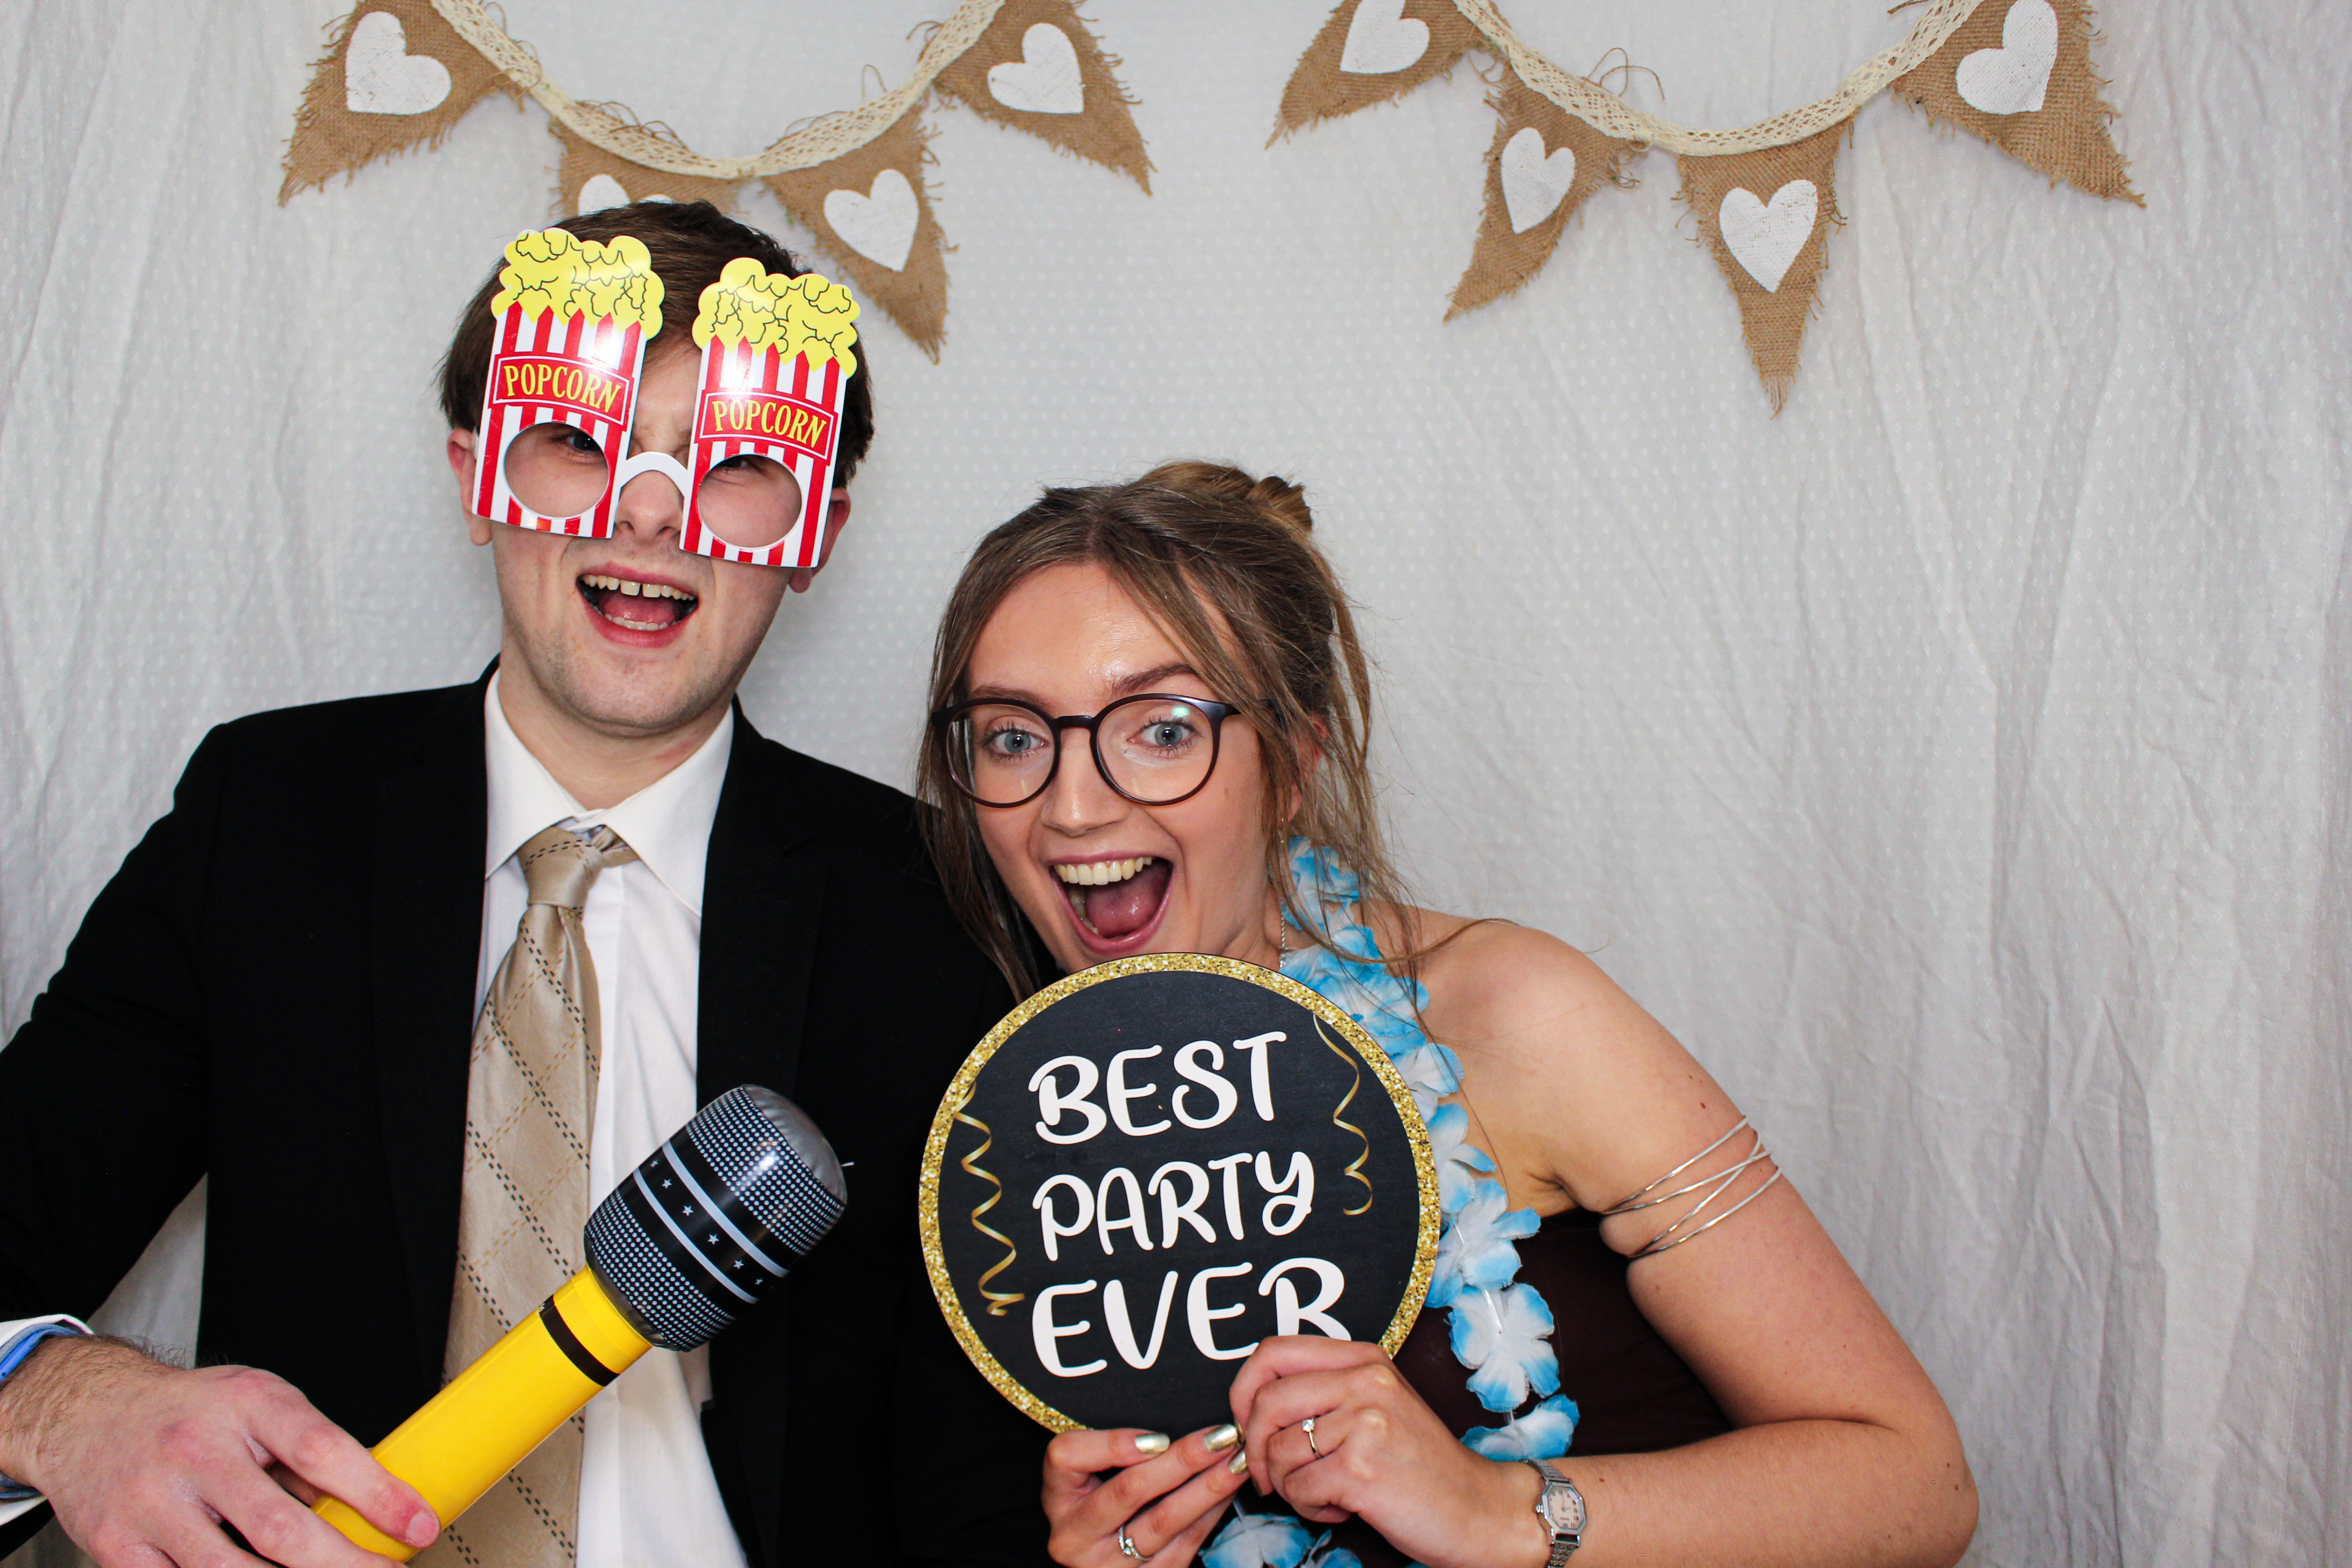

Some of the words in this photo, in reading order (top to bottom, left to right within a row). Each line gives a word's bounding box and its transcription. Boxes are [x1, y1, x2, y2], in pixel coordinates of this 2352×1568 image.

[505, 363, 621, 413] POPCORN
[712, 400, 827, 447] POPCORN
[1028, 1031, 1286, 1144] BEST
[1032, 1151, 1315, 1261] PARTY
[1032, 1257, 1351, 1377] EVER
